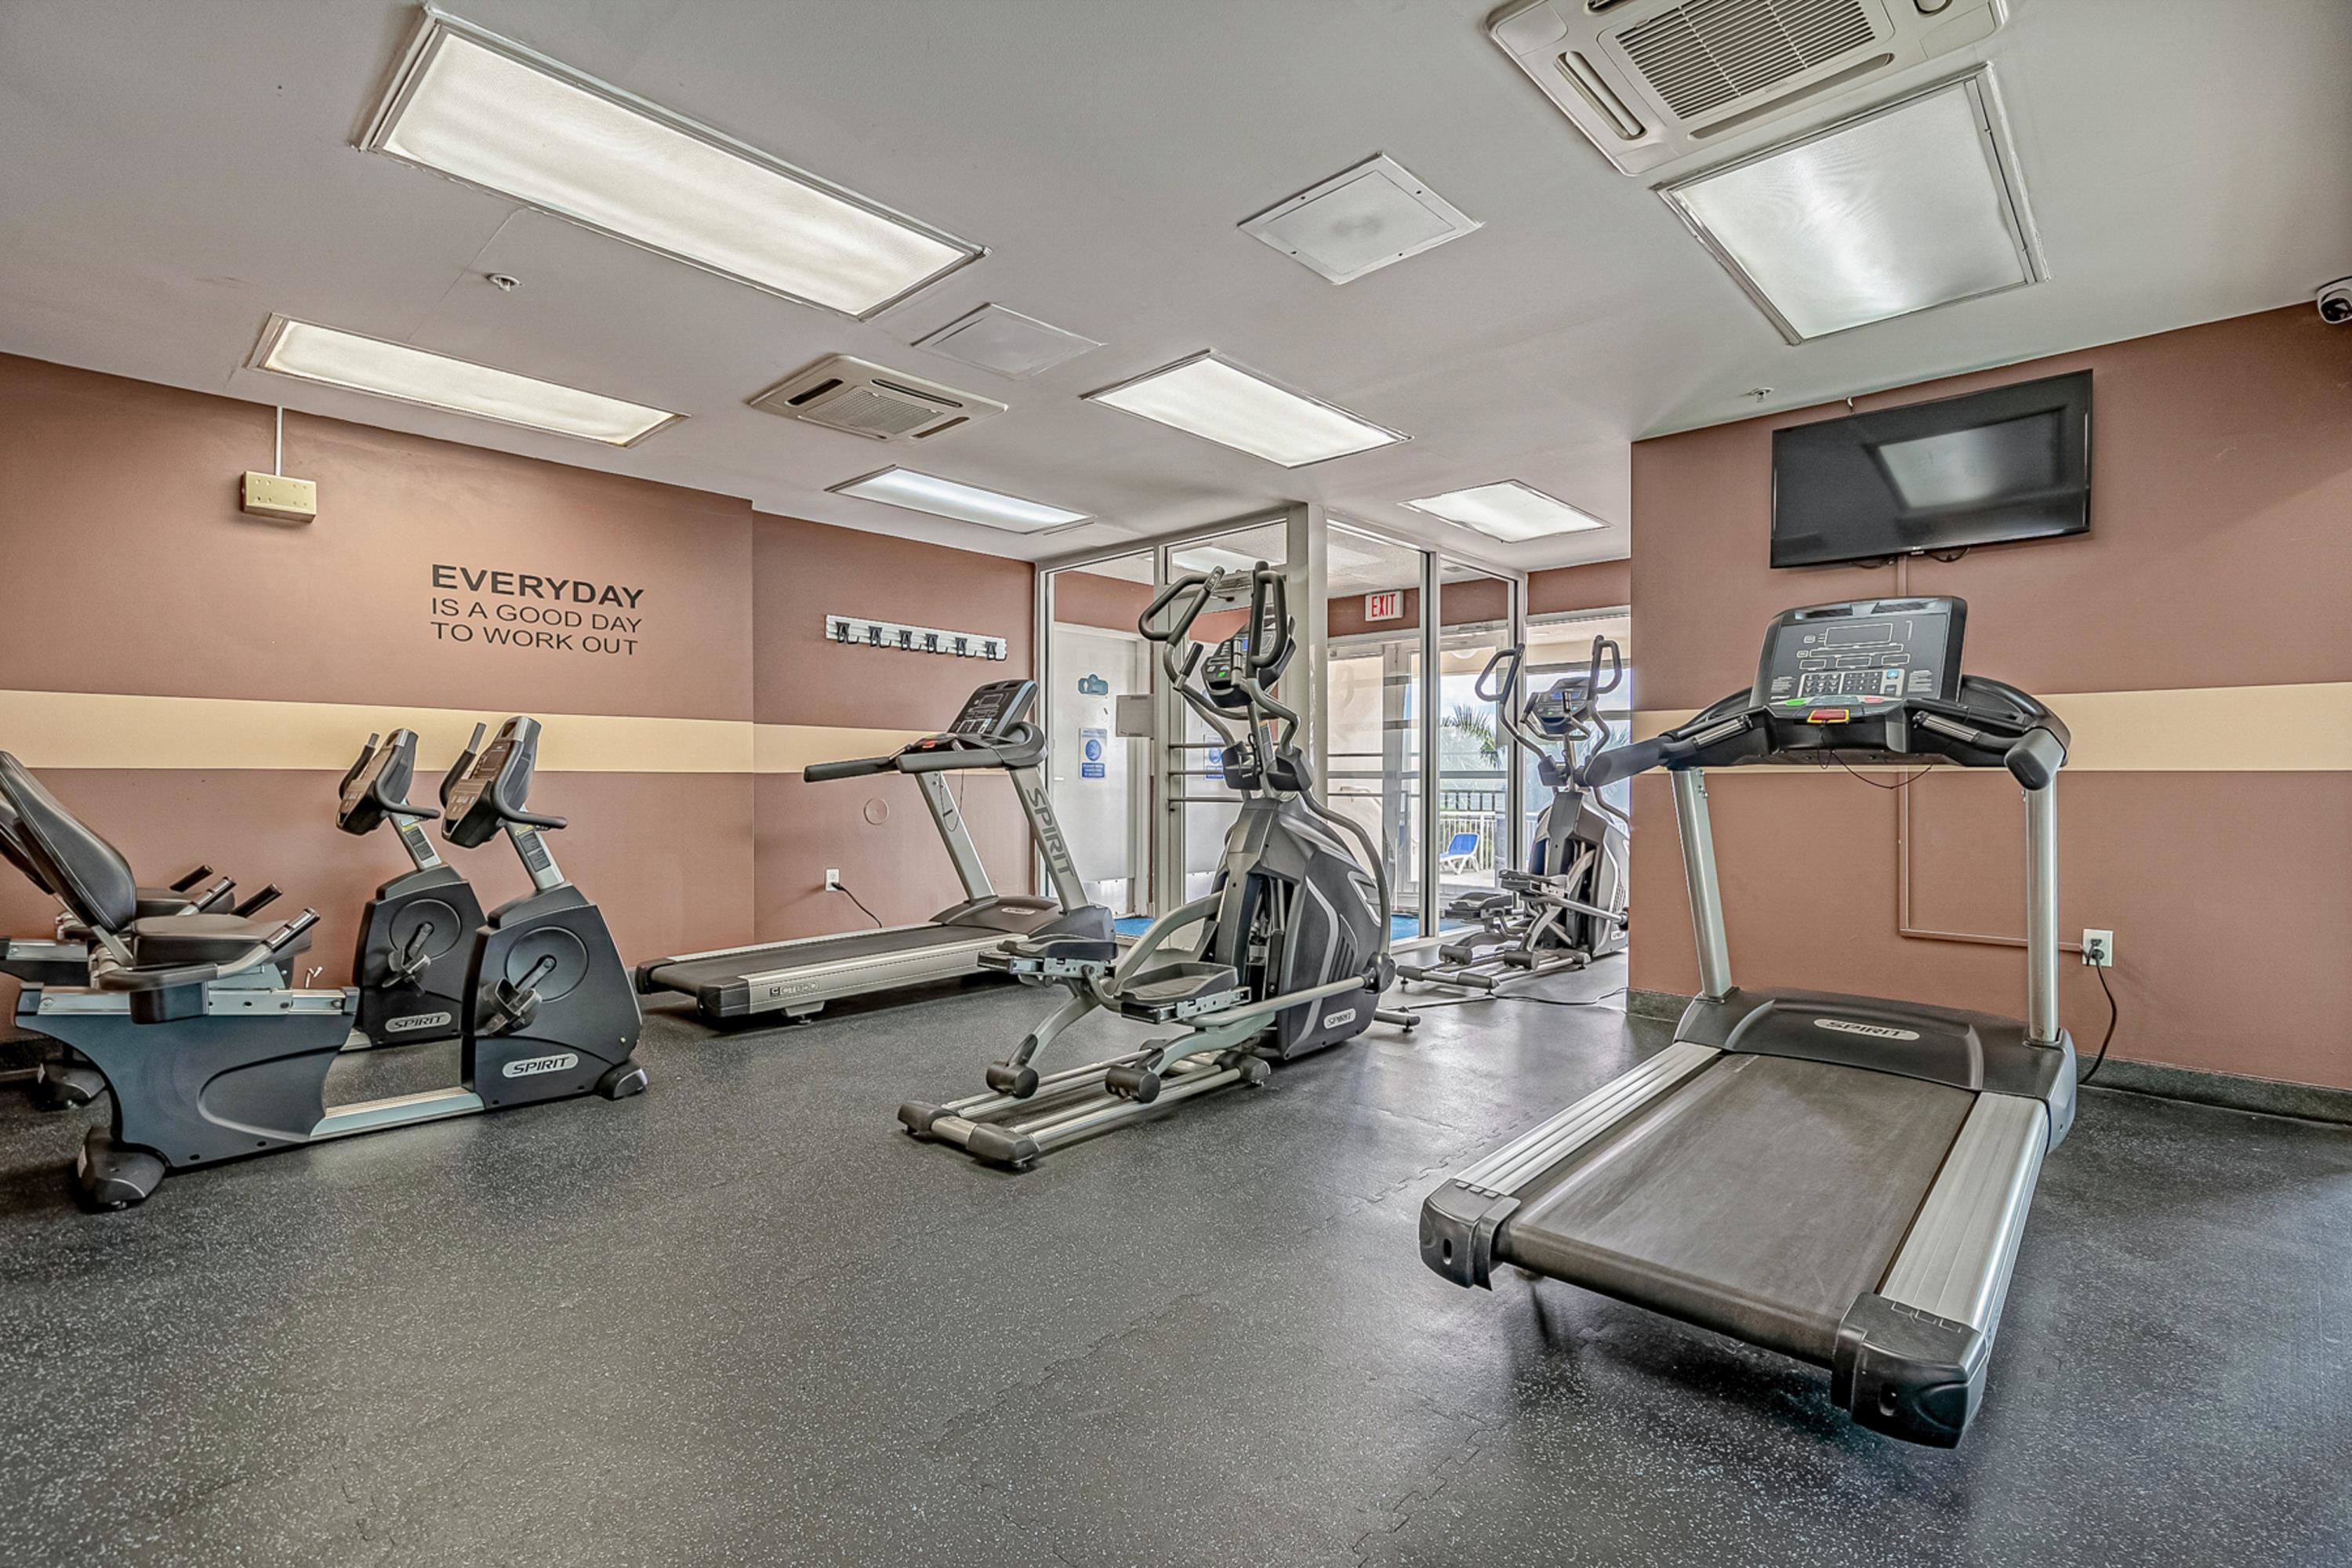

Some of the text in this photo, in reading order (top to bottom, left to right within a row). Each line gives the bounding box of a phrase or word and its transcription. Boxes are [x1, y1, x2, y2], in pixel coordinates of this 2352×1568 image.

[432, 564, 644, 609] EVERYDAY
[432, 597, 643, 633] IS A GOOD DAY
[1371, 593, 1396, 617] EXIT
[430, 621, 639, 655] TO WORK OUT
[1025, 787, 1075, 877] SPIRIT
[394, 1014, 445, 1029] SPIRIT
[1827, 1021, 1907, 1036] SPIRIT
[512, 1056, 570, 1075] SPIRIT
